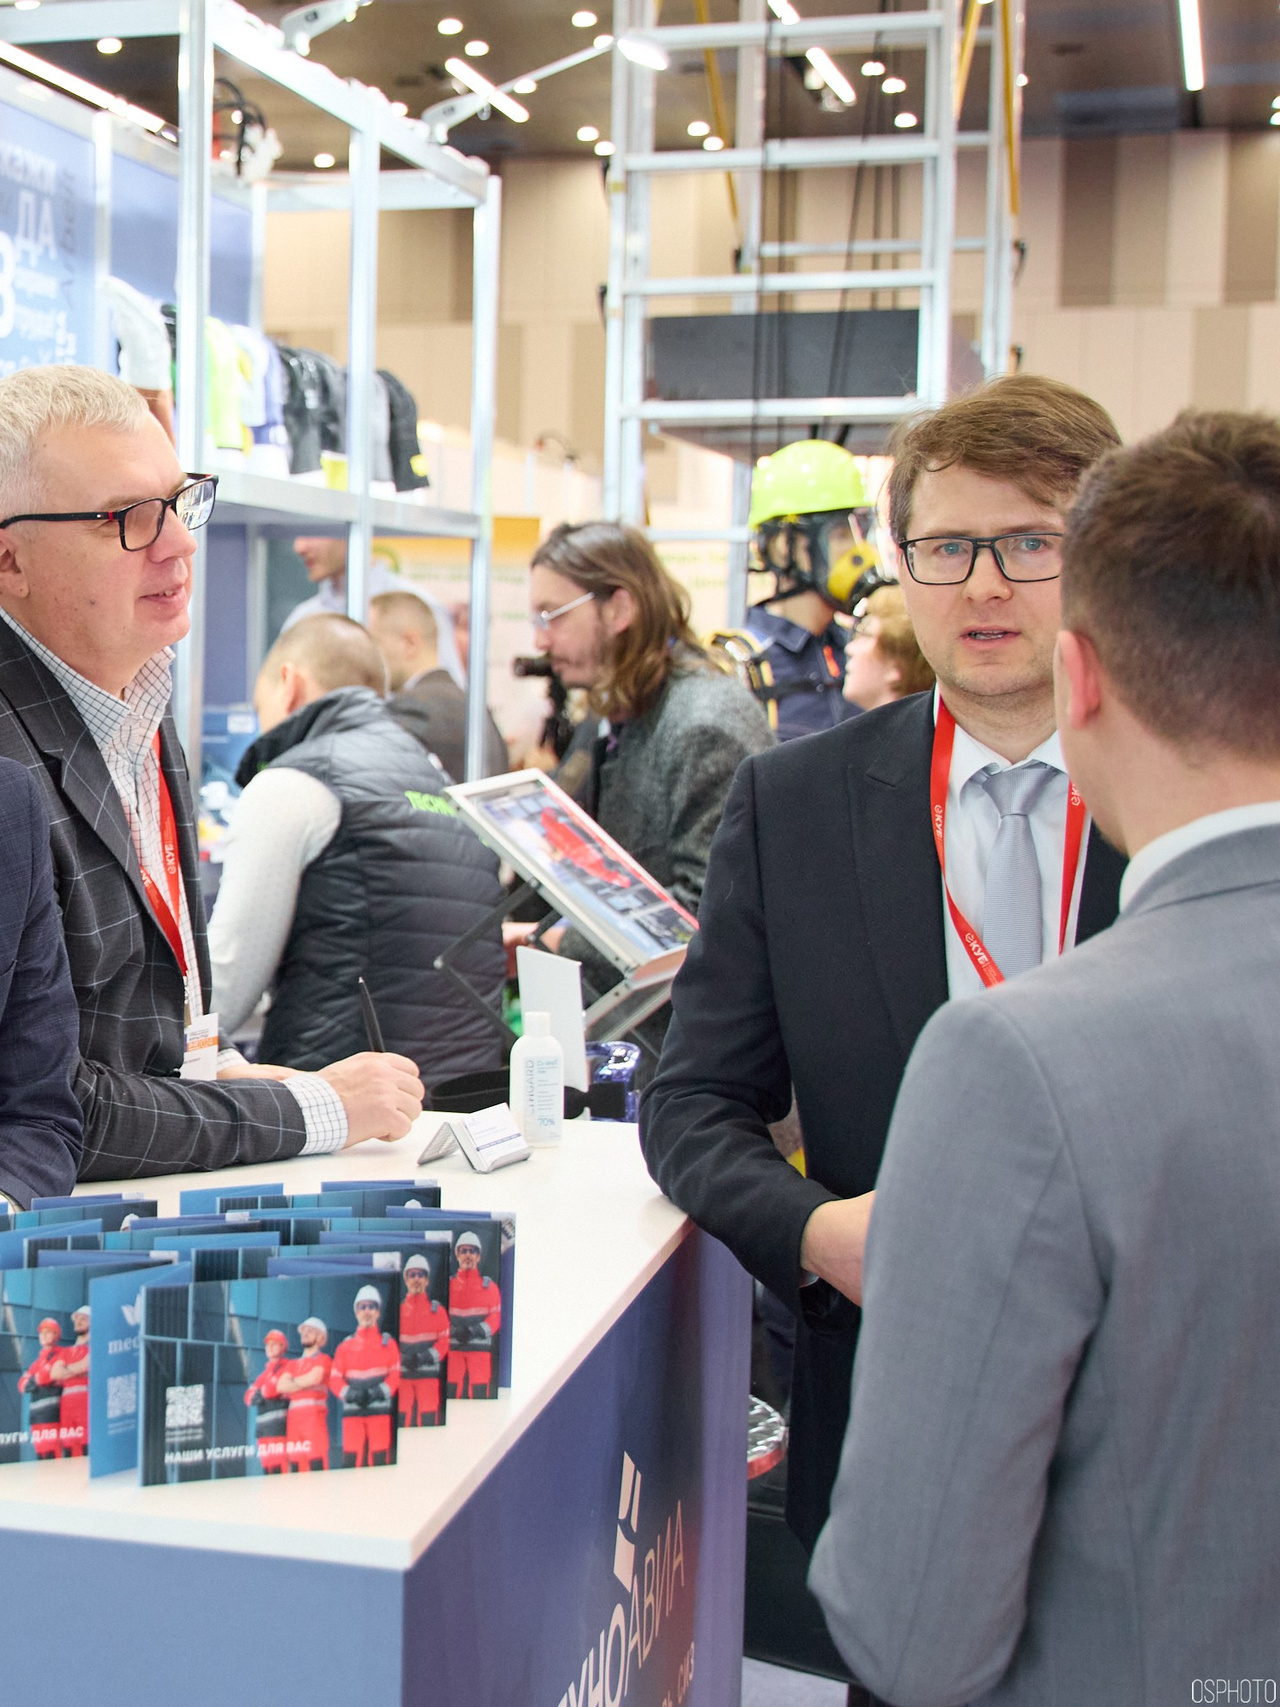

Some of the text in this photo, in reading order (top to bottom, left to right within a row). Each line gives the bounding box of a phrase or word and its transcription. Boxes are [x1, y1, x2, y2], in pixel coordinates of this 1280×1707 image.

[31, 1428, 58, 1444] ДЛЯ
[59, 1426, 85, 1440] ВАС
[164, 1439, 313, 1465] НАШИ УСЛУГИ ДЛЯ ВАС
